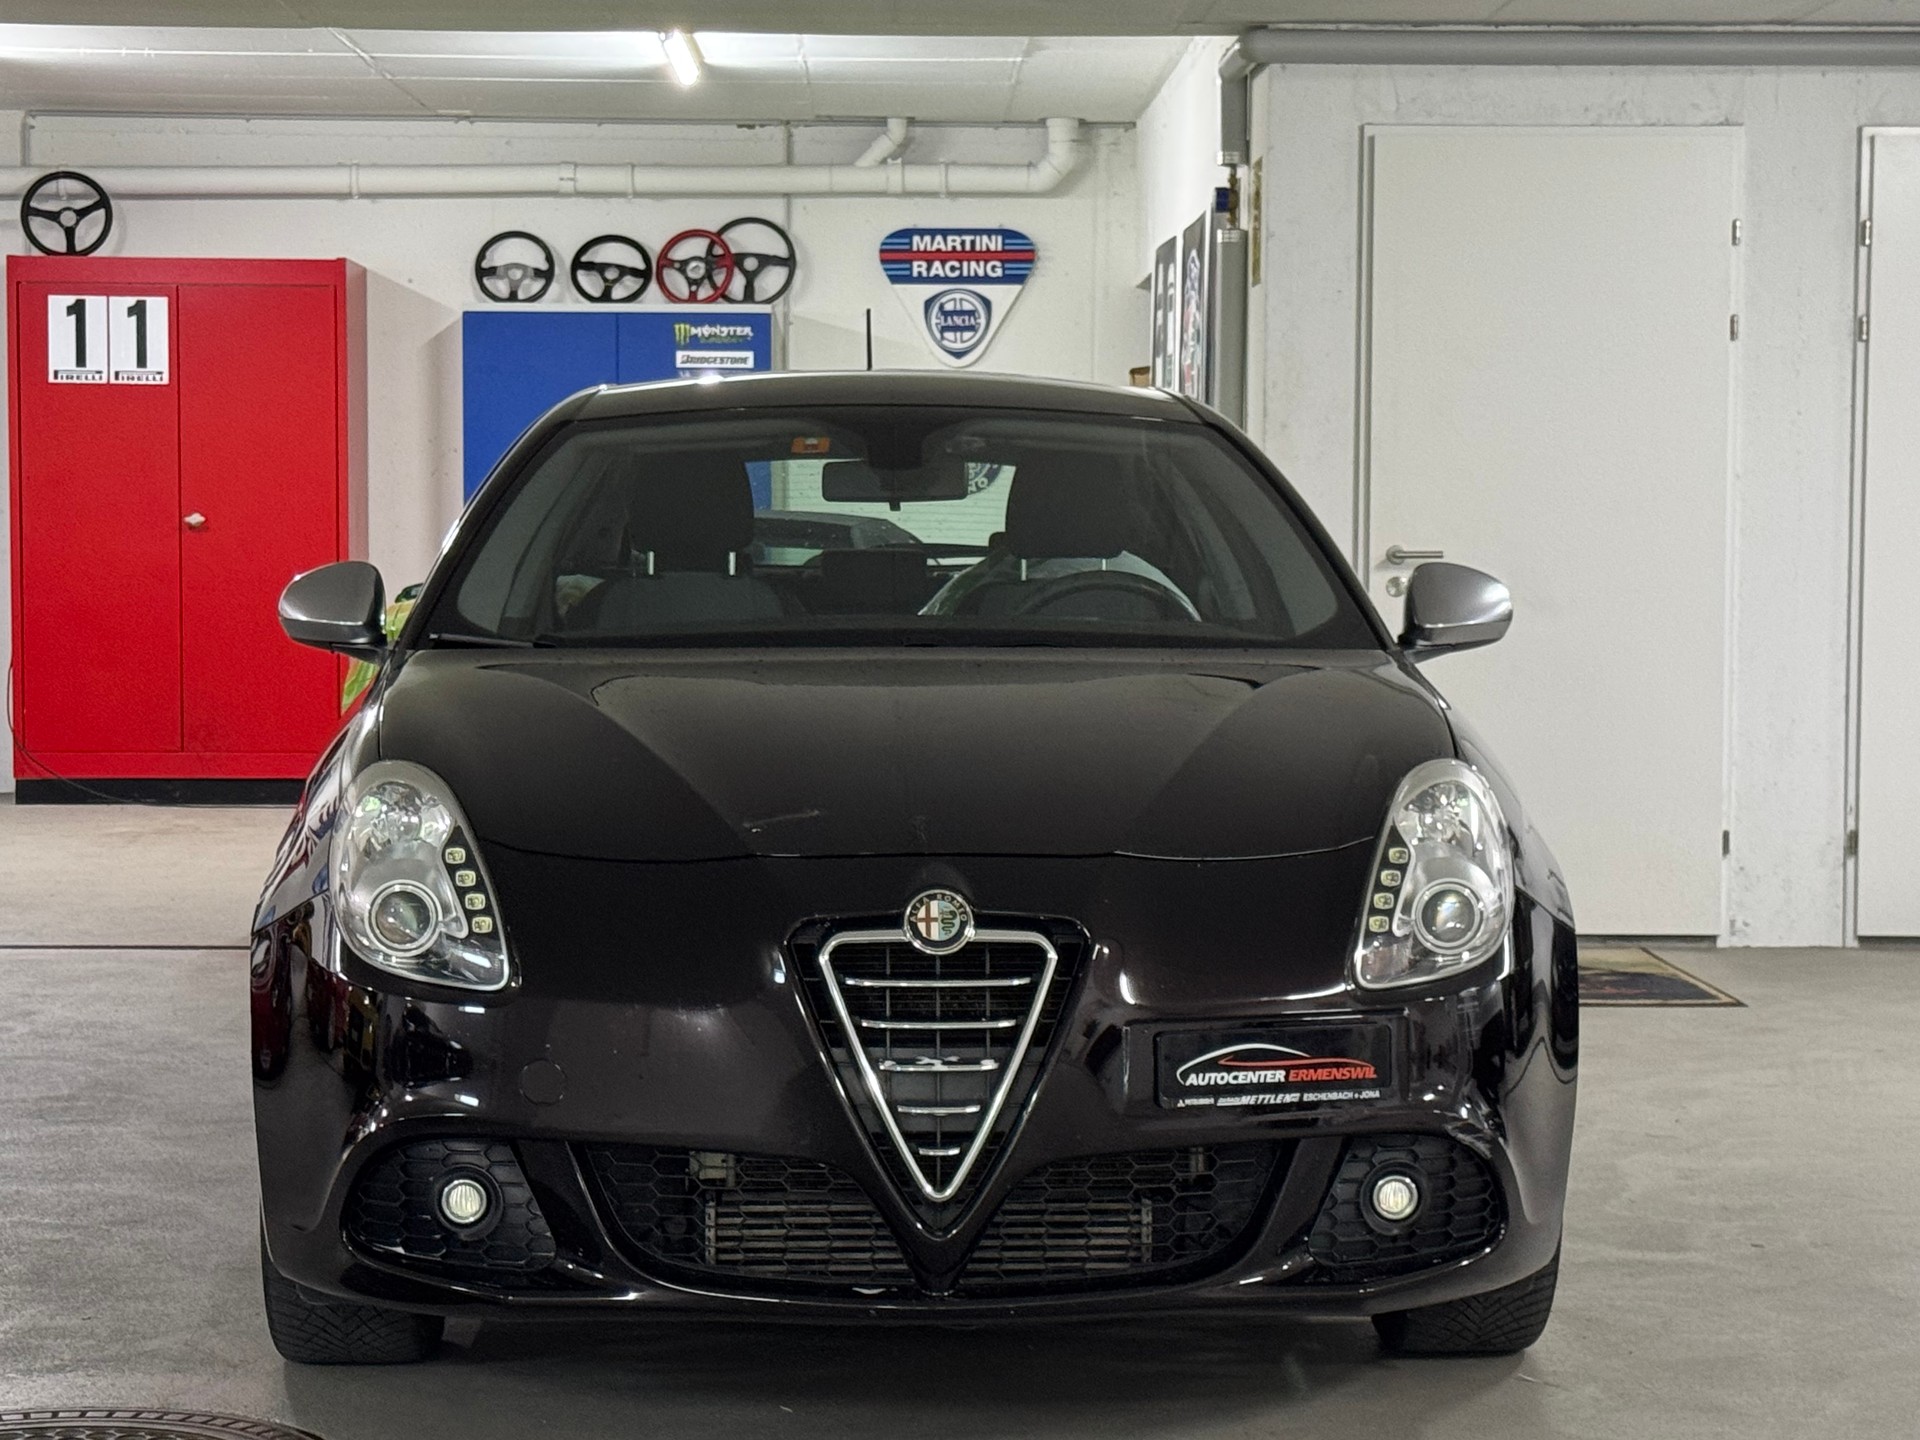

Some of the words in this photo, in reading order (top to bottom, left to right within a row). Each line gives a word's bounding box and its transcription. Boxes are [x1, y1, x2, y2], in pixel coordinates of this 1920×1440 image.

[912, 235, 1003, 252] MARTINI
[912, 261, 1003, 277] RACING
[940, 315, 976, 327] LANCIA
[690, 324, 753, 338] MONSTER
[680, 355, 750, 366] BRIDGESTONE
[909, 897, 929, 923] ALFA
[936, 894, 967, 921] ROMEO
[1185, 1070, 1286, 1086] AUTOCENTER
[1288, 1067, 1377, 1082] ERMENSWIL
